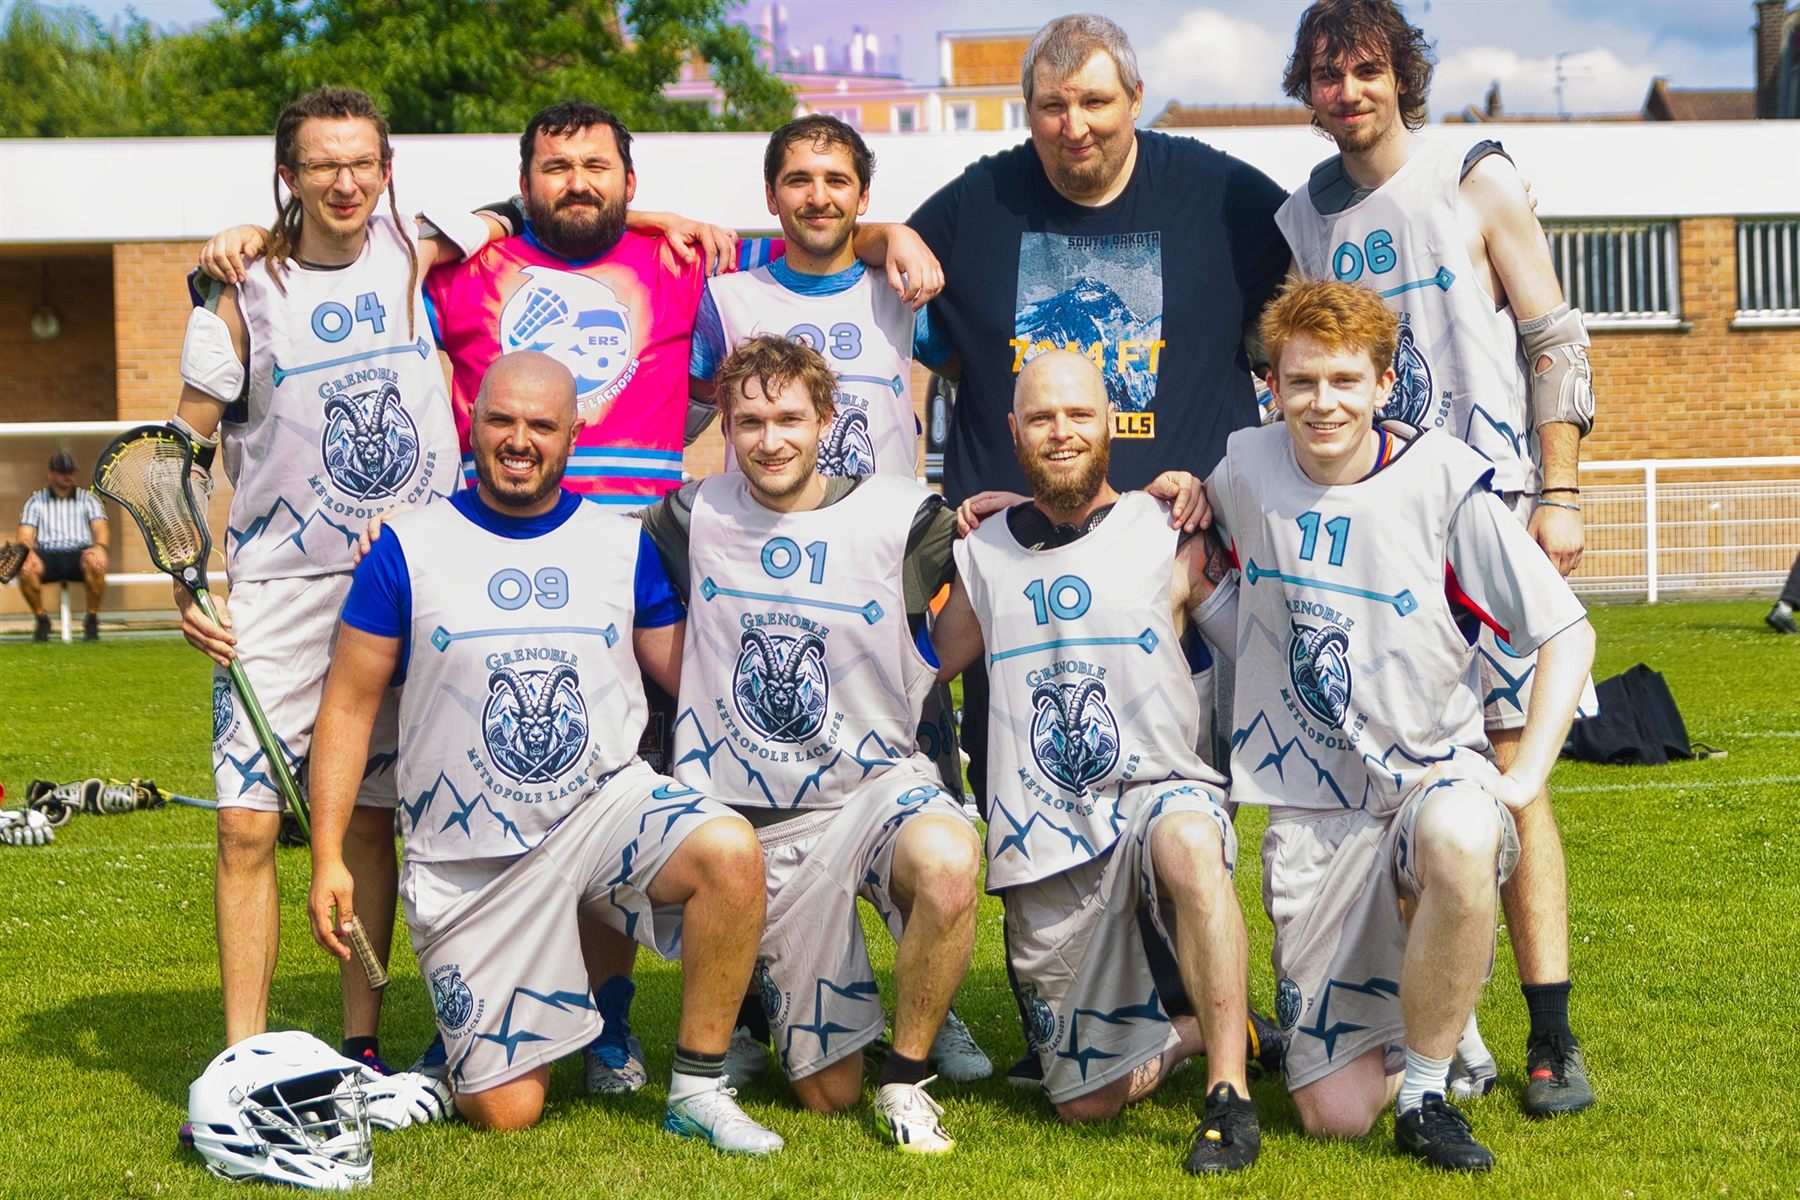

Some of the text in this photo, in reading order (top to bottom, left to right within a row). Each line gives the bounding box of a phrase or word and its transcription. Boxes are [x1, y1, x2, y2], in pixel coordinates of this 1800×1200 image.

[1068, 236, 1108, 247] SOUTH
[1112, 232, 1159, 245] DAKOTA
[1333, 229, 1397, 283] 06
[311, 291, 386, 343] 04
[588, 335, 619, 346] ERS
[1009, 339, 1166, 374] 74 FT
[318, 367, 399, 400] GRENOBLE
[590, 358, 640, 410] LACROSSE
[833, 391, 870, 411] OBLE
[1115, 416, 1152, 435] LLS
[1434, 390, 1453, 428] OSSE
[400, 450, 437, 505] CROSSE
[1295, 510, 1351, 567] 11
[760, 536, 828, 584] 01
[488, 566, 569, 611] 09
[1023, 574, 1092, 625] 10
[740, 612, 830, 640] GRENOBLE
[1288, 600, 1355, 632] ENOBLE
[485, 647, 578, 671] GRENOBLE
[1025, 660, 1107, 687] GRENOBLE
[714, 697, 844, 763] METROPOLE LACROSSE
[466, 747, 543, 804] METROPOLE
